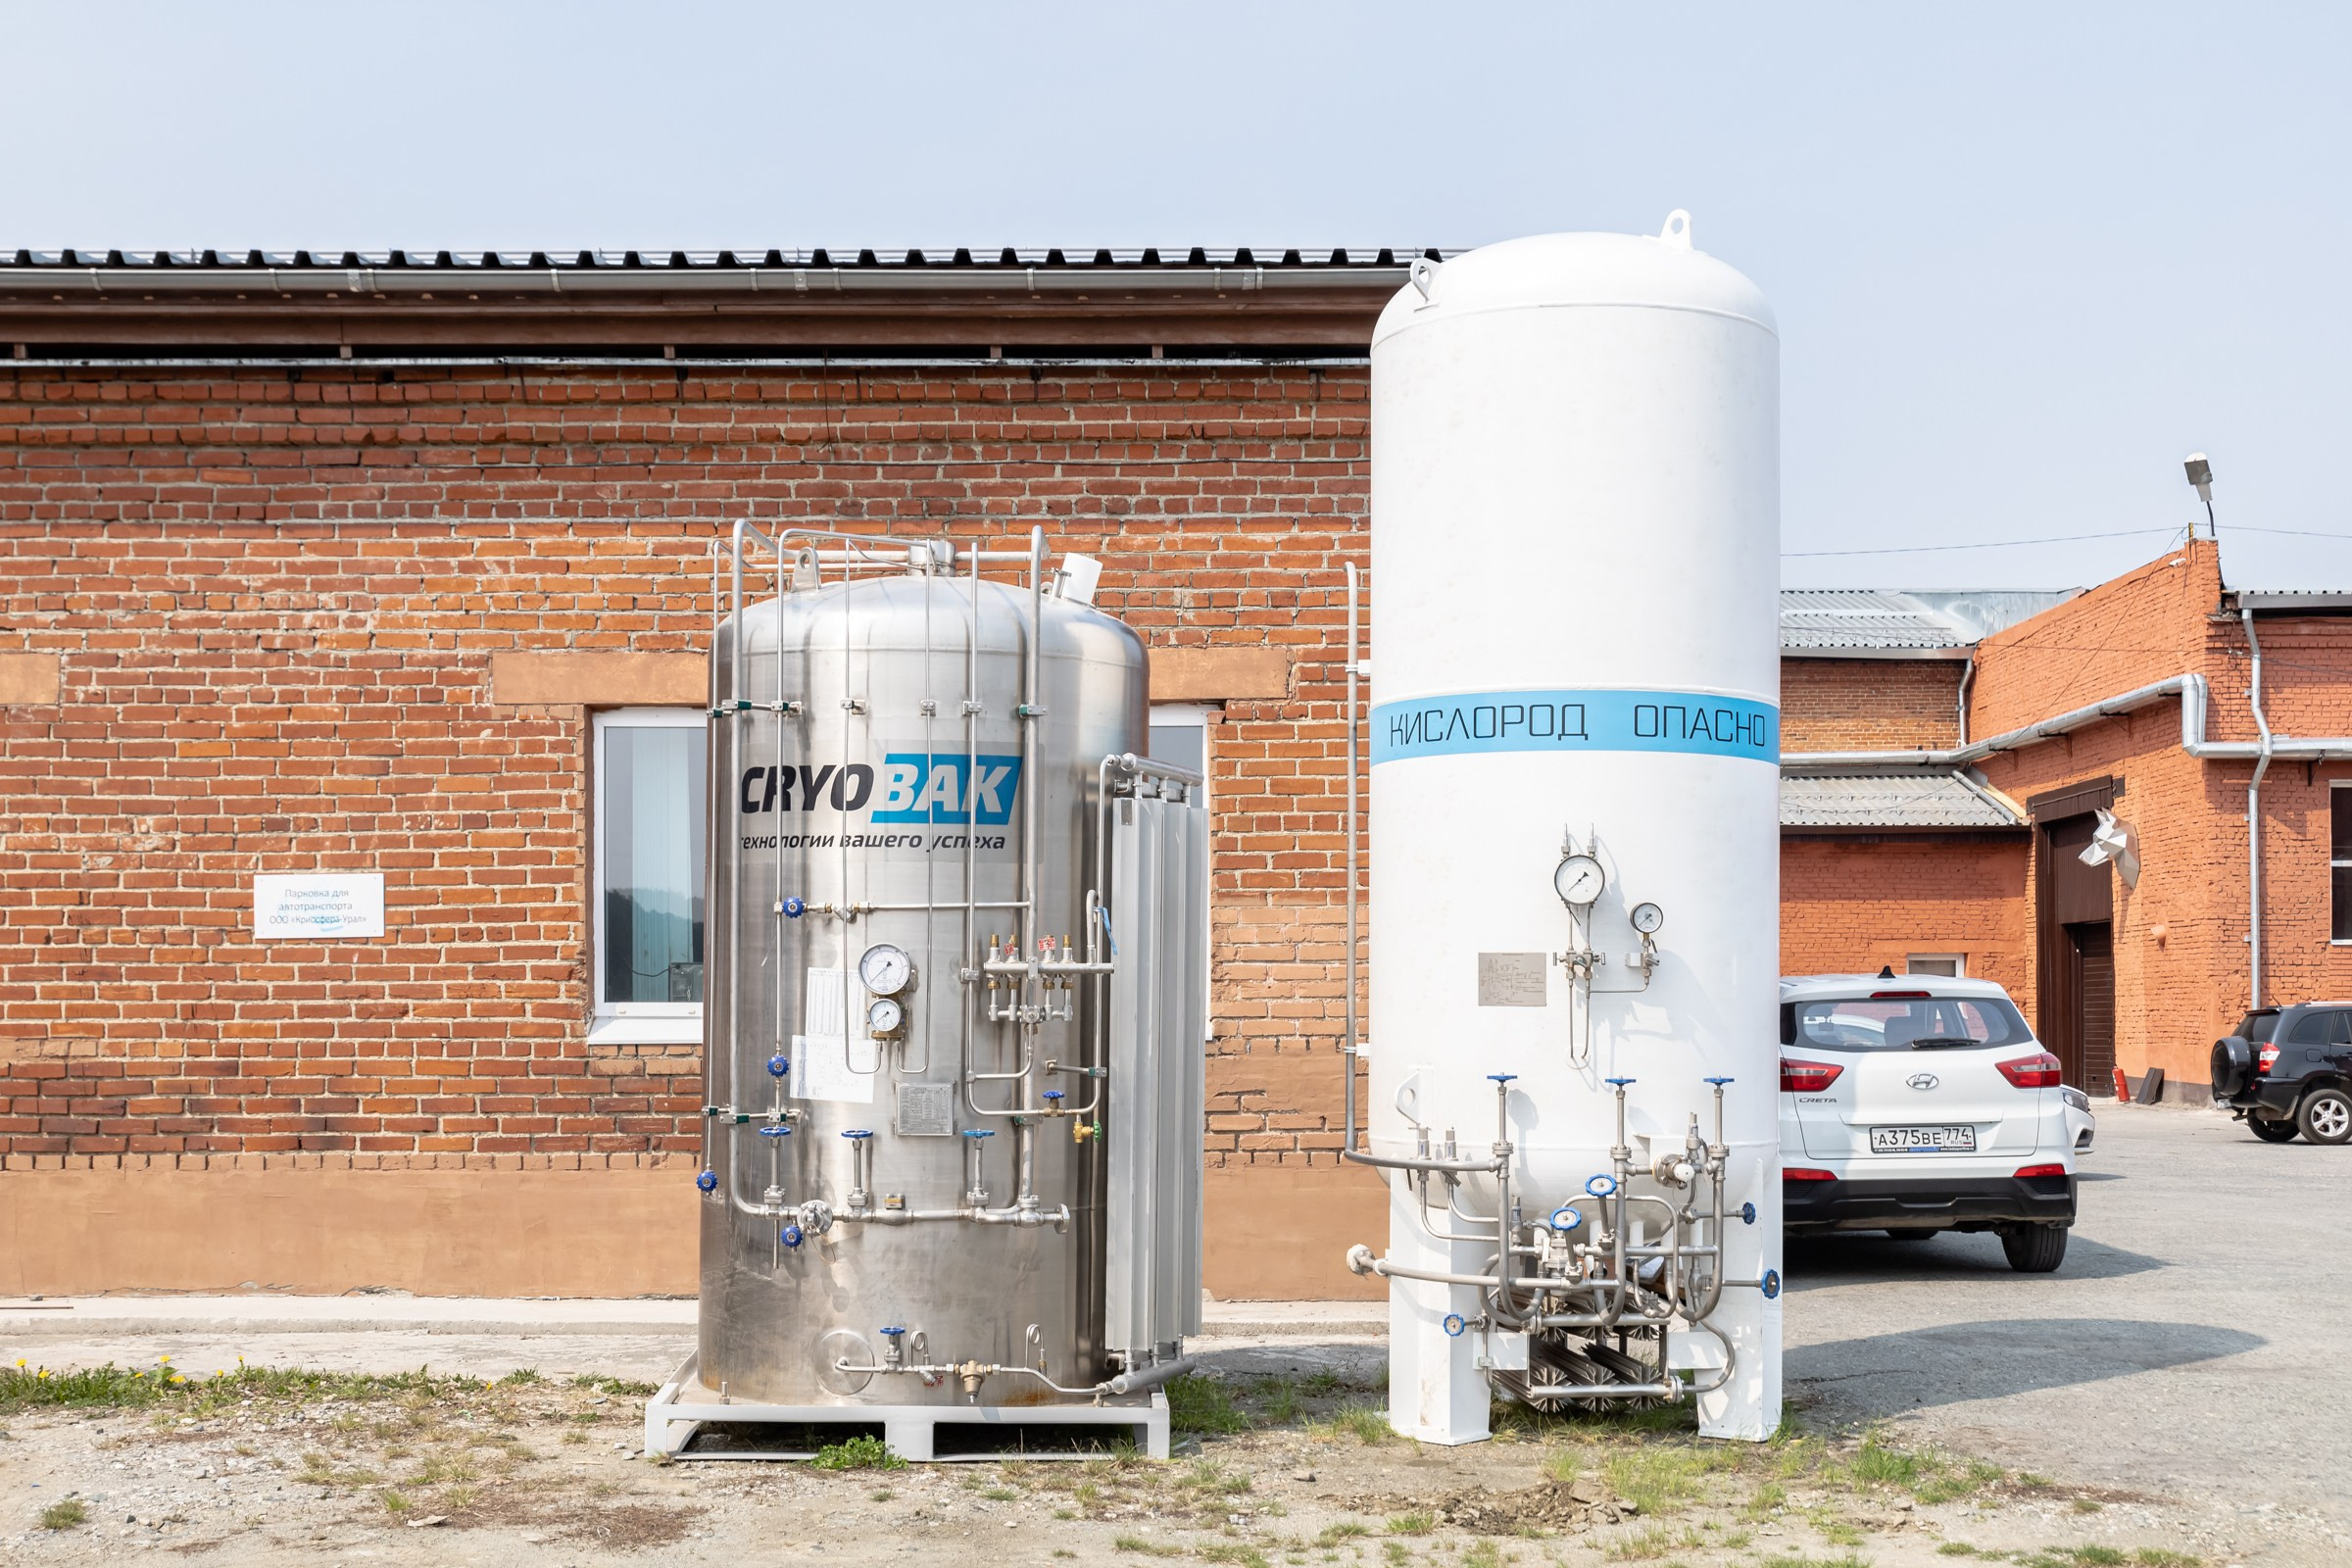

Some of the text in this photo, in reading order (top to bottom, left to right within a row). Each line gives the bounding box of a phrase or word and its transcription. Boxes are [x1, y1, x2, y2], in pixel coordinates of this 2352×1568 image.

[1390, 704, 1766, 747] КИСЛОРОД ОПАСНО
[741, 835, 1005, 853] ехнологии вашего успеха
[284, 889, 329, 899] Парковка
[279, 903, 353, 911] автотранспорта
[270, 915, 288, 924] ООО
[1943, 1128, 1969, 1141] 774
